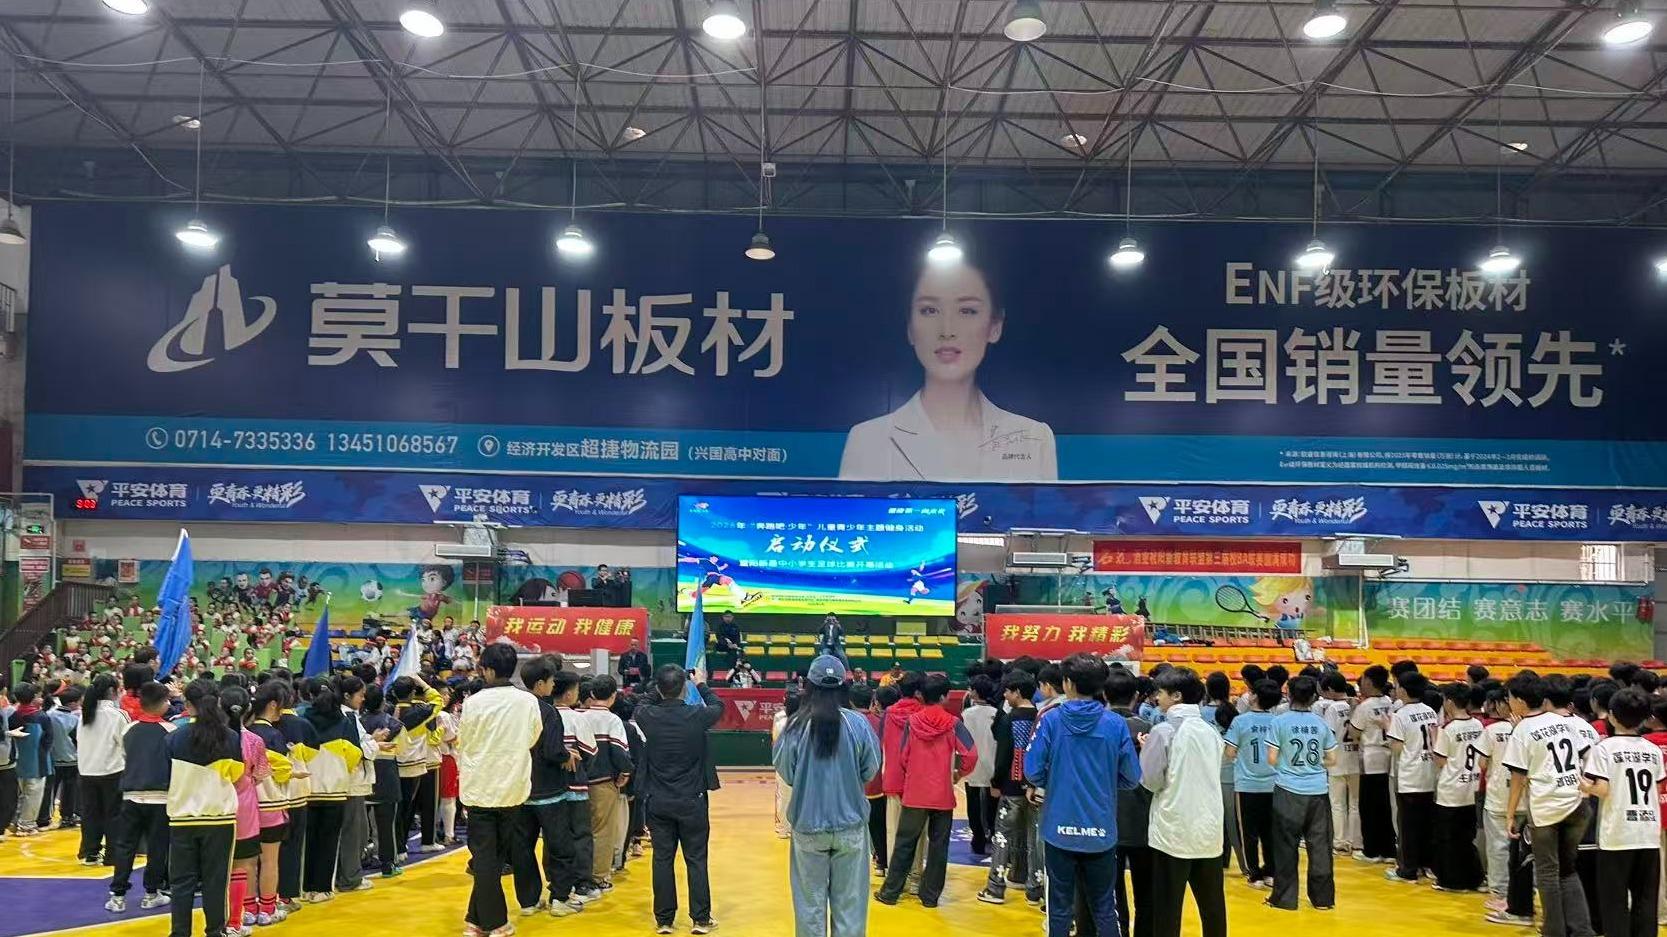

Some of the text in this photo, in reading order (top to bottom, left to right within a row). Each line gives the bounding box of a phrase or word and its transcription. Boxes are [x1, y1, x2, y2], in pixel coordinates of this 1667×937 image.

[308, 281, 794, 377] 莫干山板材
[174, 430, 459, 454] 0714-7335336 13451068567
[506, 438, 680, 460] 经济开发区超捷物流园
[110, 482, 188, 499] 平安体育
[454, 487, 531, 505] 平安体育
[146, 500, 187, 508] SPORTS
[453, 504, 531, 514] PEACE SPORTS
[1173, 499, 1250, 515] 平安体育
[1512, 503, 1588, 520] 平安体育
[1173, 515, 1249, 524] PEACE SPORTS
[1512, 520, 1588, 529] PEACE SPORTS
[764, 534, 870, 556] 启动仪式
[1386, 597, 1636, 624] 赛团结 赛意志 赛水平
[503, 616, 636, 637] 我运动 我健康
[1000, 625, 1131, 644] 我努力 我精彩
[1289, 738, 1320, 767] 28
[1465, 743, 1477, 772] 8
[1546, 738, 1577, 774] 12
[1625, 767, 1653, 806] 19
[1057, 825, 1098, 837] KELME
